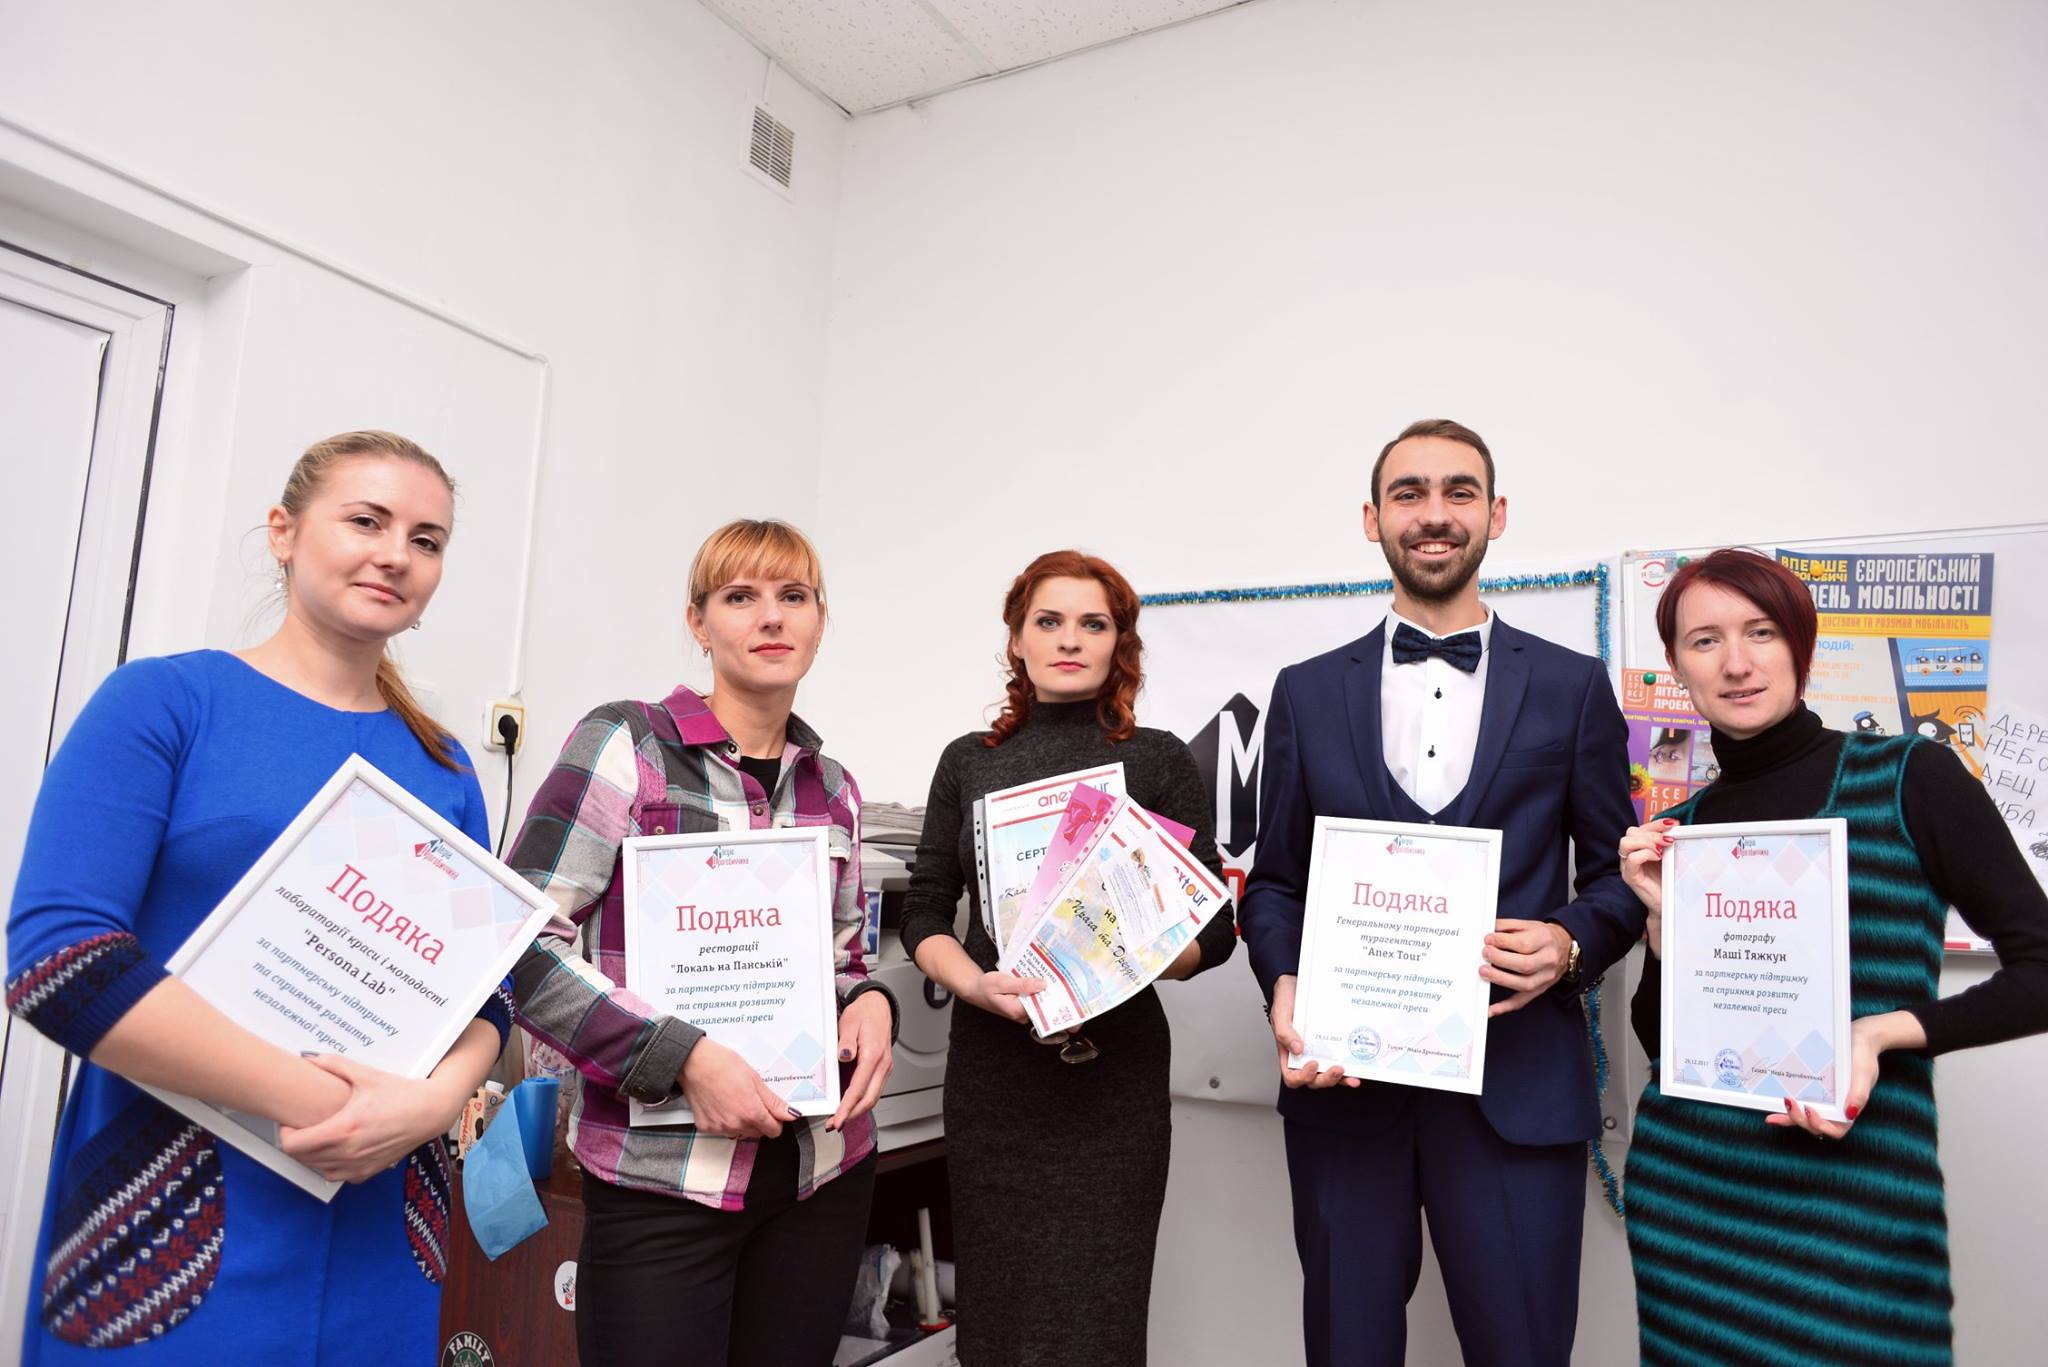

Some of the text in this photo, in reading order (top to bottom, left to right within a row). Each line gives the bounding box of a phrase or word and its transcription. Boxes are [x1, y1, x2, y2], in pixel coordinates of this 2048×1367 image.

[1857, 585, 1980, 611] МОБІЛЬНОСТІ
[1352, 882, 1448, 914] Подяка
[1705, 893, 1797, 923] Подяка
[326, 864, 445, 965] Подяка
[676, 905, 782, 934] Подяка
[1336, 916, 1460, 936] Генеральному партнерові
[275, 886, 450, 1008] лабораторії краси і молодості
[1360, 934, 1432, 949] турагентству
[1723, 931, 1776, 944] фотографу
[699, 941, 760, 956] ресторації
[1363, 946, 1427, 961] "Anex Tour"
[1713, 948, 1787, 964] Маші Тяжкун
[304, 929, 396, 996] "Persona Lab"
[671, 958, 788, 974] "Локаль на Панській"
[256, 936, 400, 1037] за партнерську підтримку
[665, 979, 796, 995] за партнерську підтримку
[1344, 967, 1401, 981] партнерську
[1403, 972, 1454, 988] підтримку
[1694, 969, 1809, 985] за партнерську підтримку
[1340, 981, 1443, 1002] та сприяння розвитку
[1715, 986, 1755, 997] сприяння
[1756, 989, 1799, 1002] розвитку
[253, 961, 375, 1048] та сприяння розвитку
[676, 997, 786, 1012] та сприяння розвитку
[1350, 997, 1428, 1014] незалежної преси
[1713, 1002, 1787, 1016] незалежної преси
[253, 988, 349, 1054] незалежної преси
[690, 1013, 774, 1026] незалежної преси
[449, 1335, 491, 1362] FAMILY
